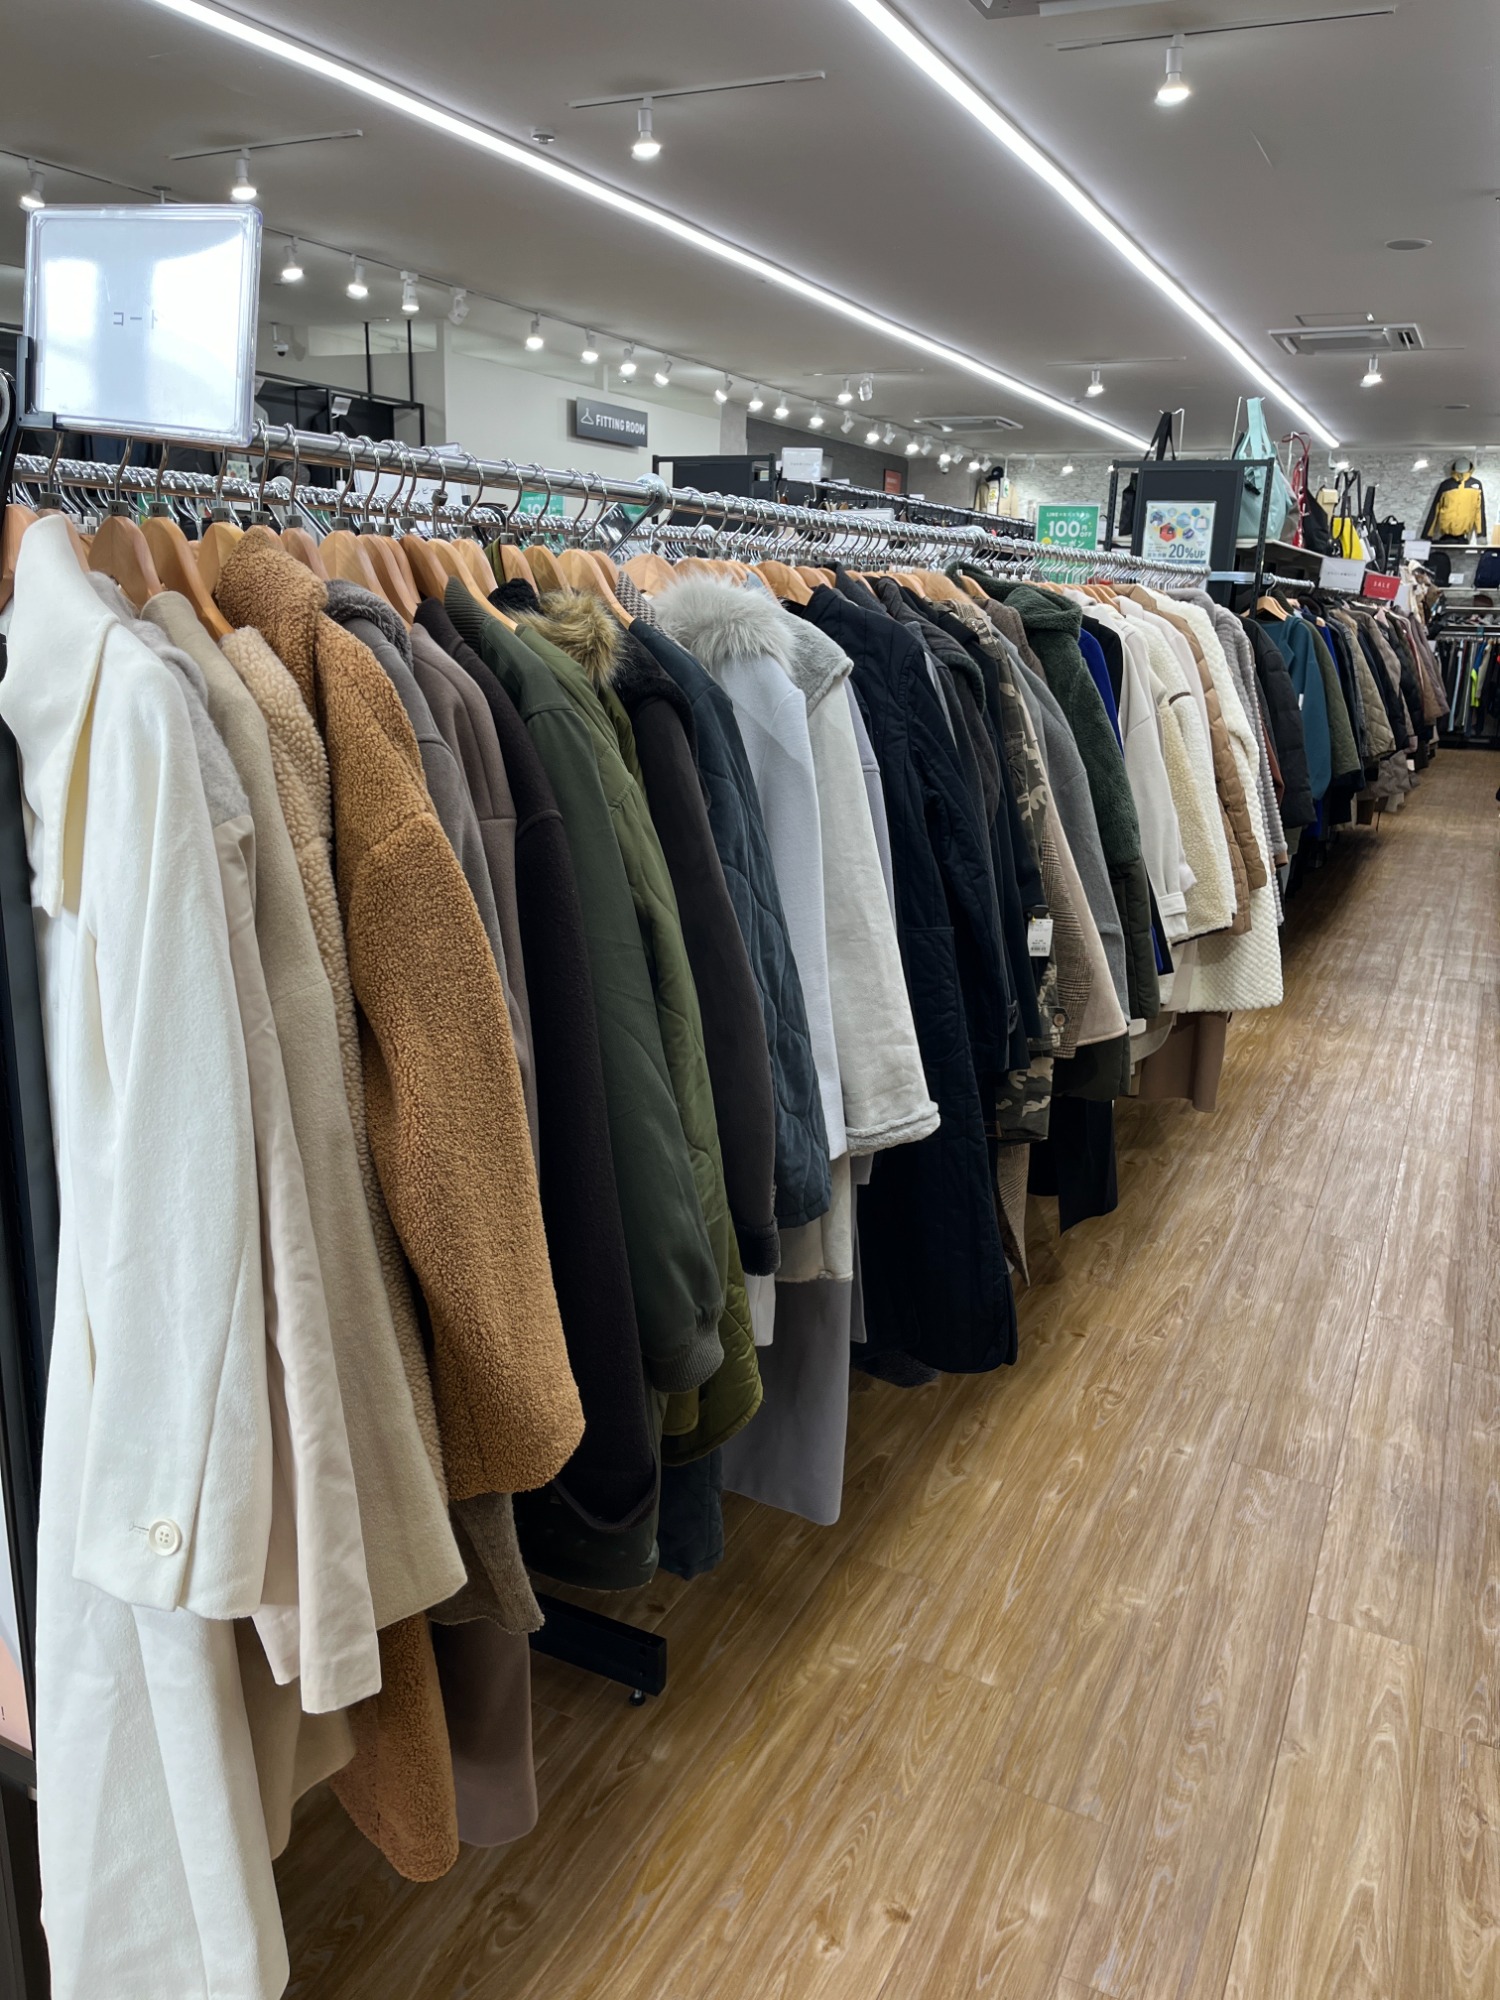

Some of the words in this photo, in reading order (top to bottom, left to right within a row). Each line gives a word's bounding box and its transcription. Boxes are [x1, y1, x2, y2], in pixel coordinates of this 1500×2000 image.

[113, 309, 159, 329] コート
[595, 414, 625, 431] FITTING
[625, 420, 646, 435] ROOM
[111, 504, 119, 513] M
[152, 505, 160, 514] M
[256, 515, 264, 523] M
[1048, 520, 1080, 538] 100
[1373, 580, 1391, 589] SALE
